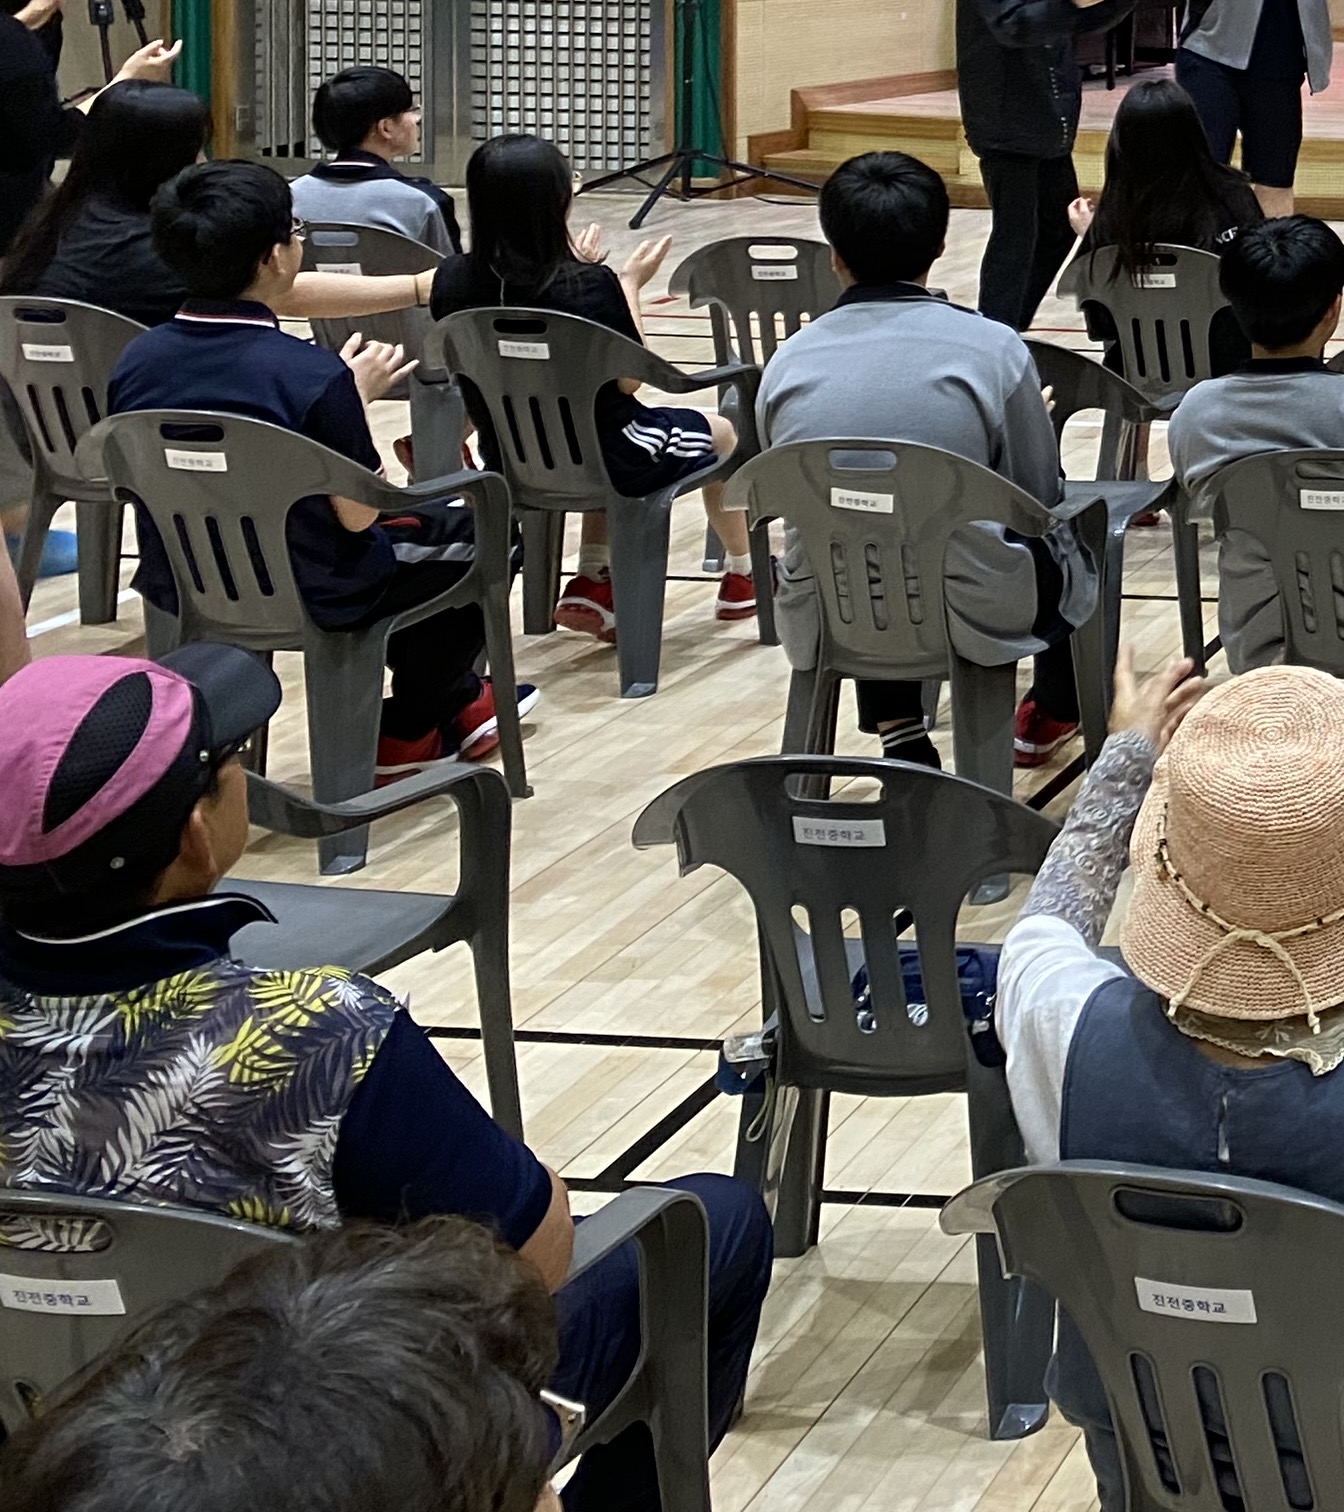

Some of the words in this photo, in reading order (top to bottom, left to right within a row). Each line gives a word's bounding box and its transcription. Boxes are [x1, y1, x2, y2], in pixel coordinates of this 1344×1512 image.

[802, 827, 865, 841] 진전중학교
[12, 1289, 92, 1306] 진전중학교
[1151, 1293, 1227, 1314] 진전중학교
